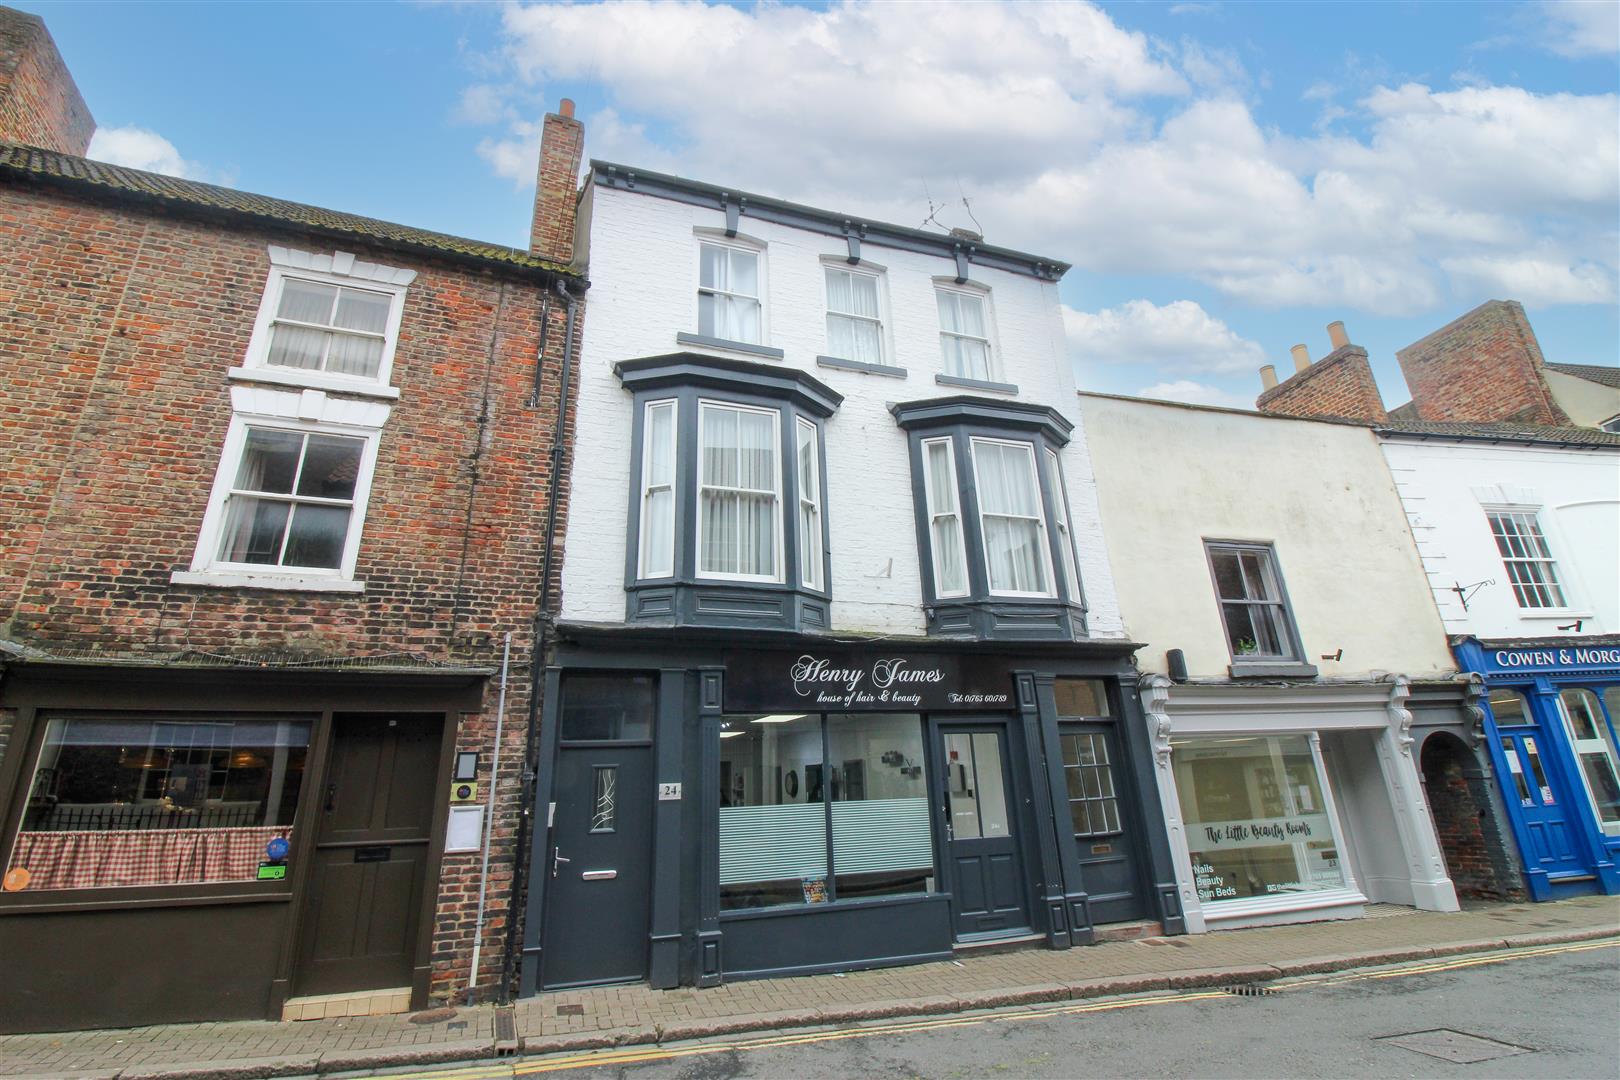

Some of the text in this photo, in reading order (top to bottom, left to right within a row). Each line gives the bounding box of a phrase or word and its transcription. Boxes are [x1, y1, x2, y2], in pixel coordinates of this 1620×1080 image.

[1495, 648, 1620, 667] COWEN & MORG
[790, 654, 946, 696] Henry James
[816, 689, 922, 707] house of hair & beauty
[664, 785, 677, 796] 24
[1204, 821, 1312, 844] The Little Beauty Rooms
[1192, 863, 1215, 875] Nails
[1195, 875, 1224, 887] Beauty
[1198, 886, 1237, 899] Sun Beds
